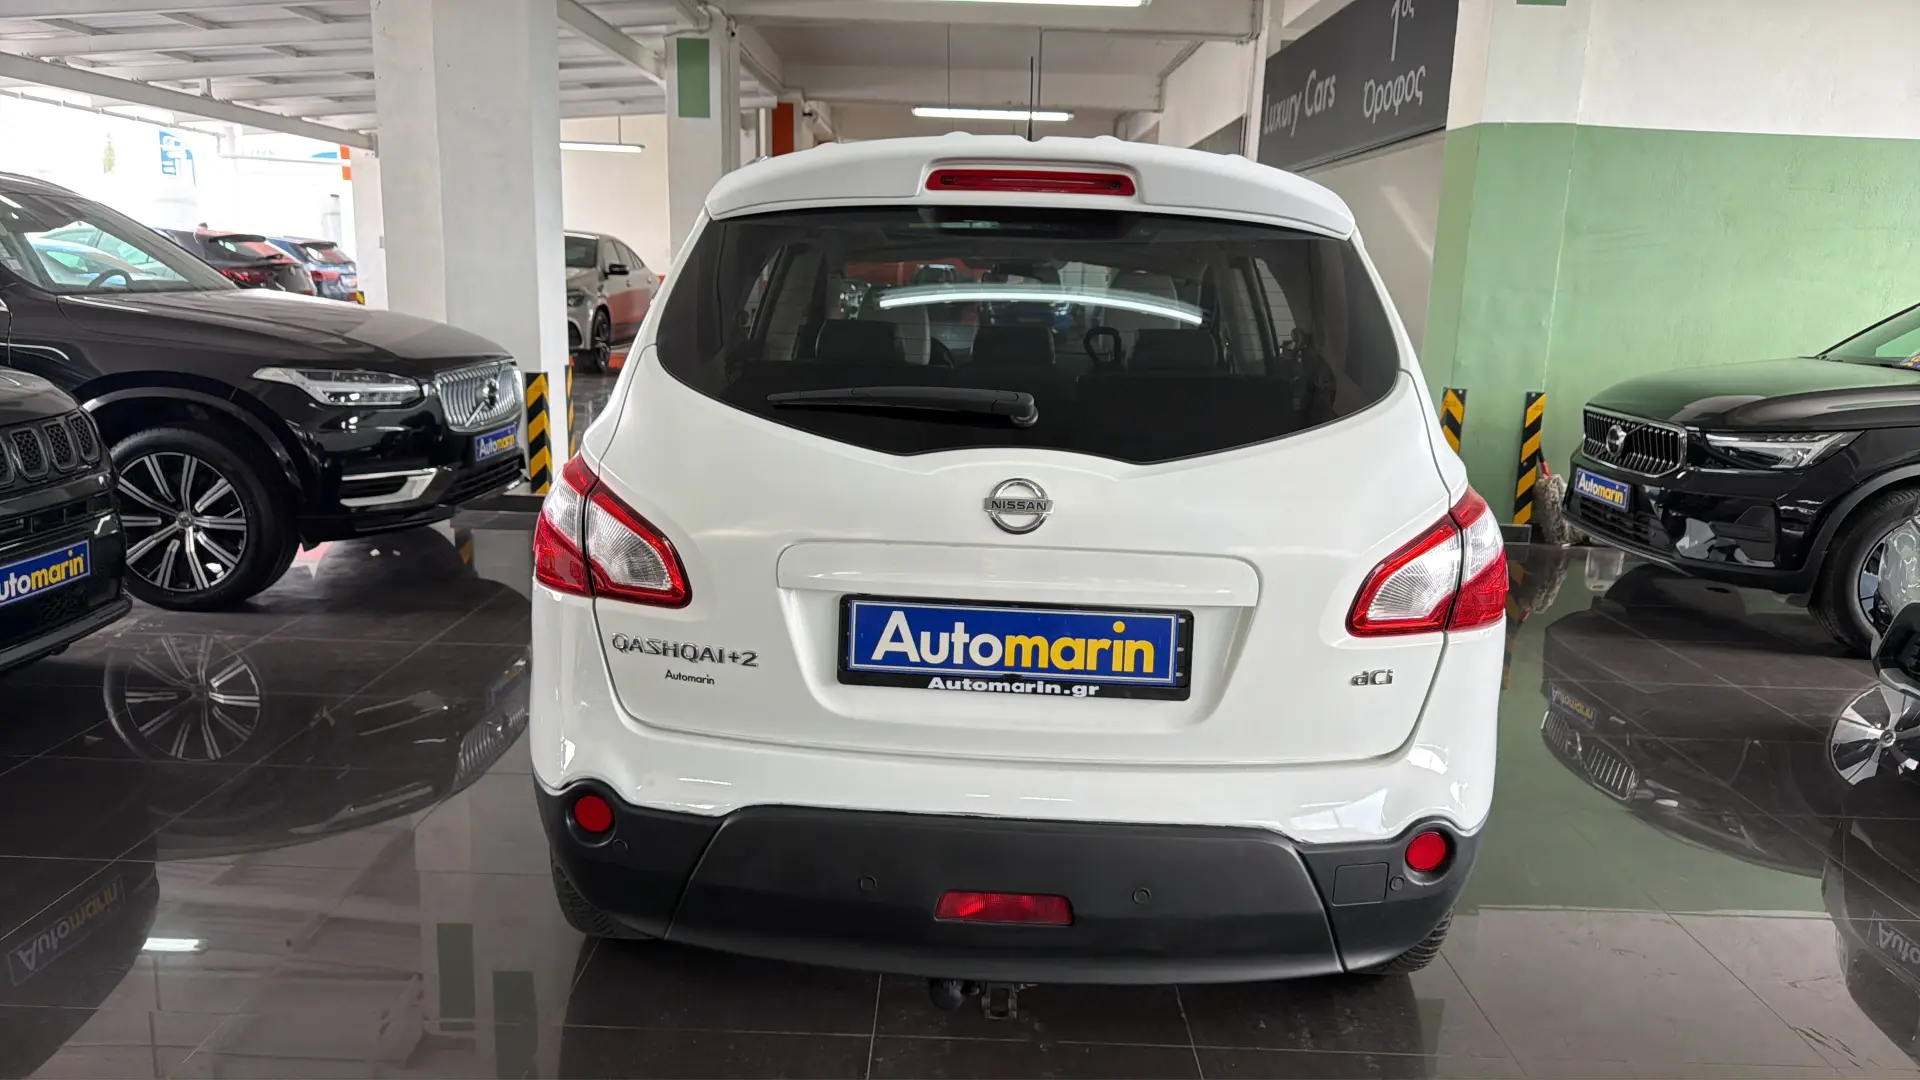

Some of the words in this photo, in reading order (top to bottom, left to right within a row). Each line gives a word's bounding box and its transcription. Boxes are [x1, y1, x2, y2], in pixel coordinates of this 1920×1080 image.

[1263, 92, 1302, 137] Luxury
[1304, 69, 1336, 117] Cars
[479, 431, 515, 457] Automarin
[1578, 472, 1624, 504] Automarin
[991, 500, 1046, 511] NISSAN
[612, 632, 759, 667] QASHQAI+2
[871, 610, 1155, 674] Automarin
[664, 669, 715, 686] Automarin
[927, 677, 1099, 698] Automarin.gr
[1350, 669, 1394, 687] dCi
